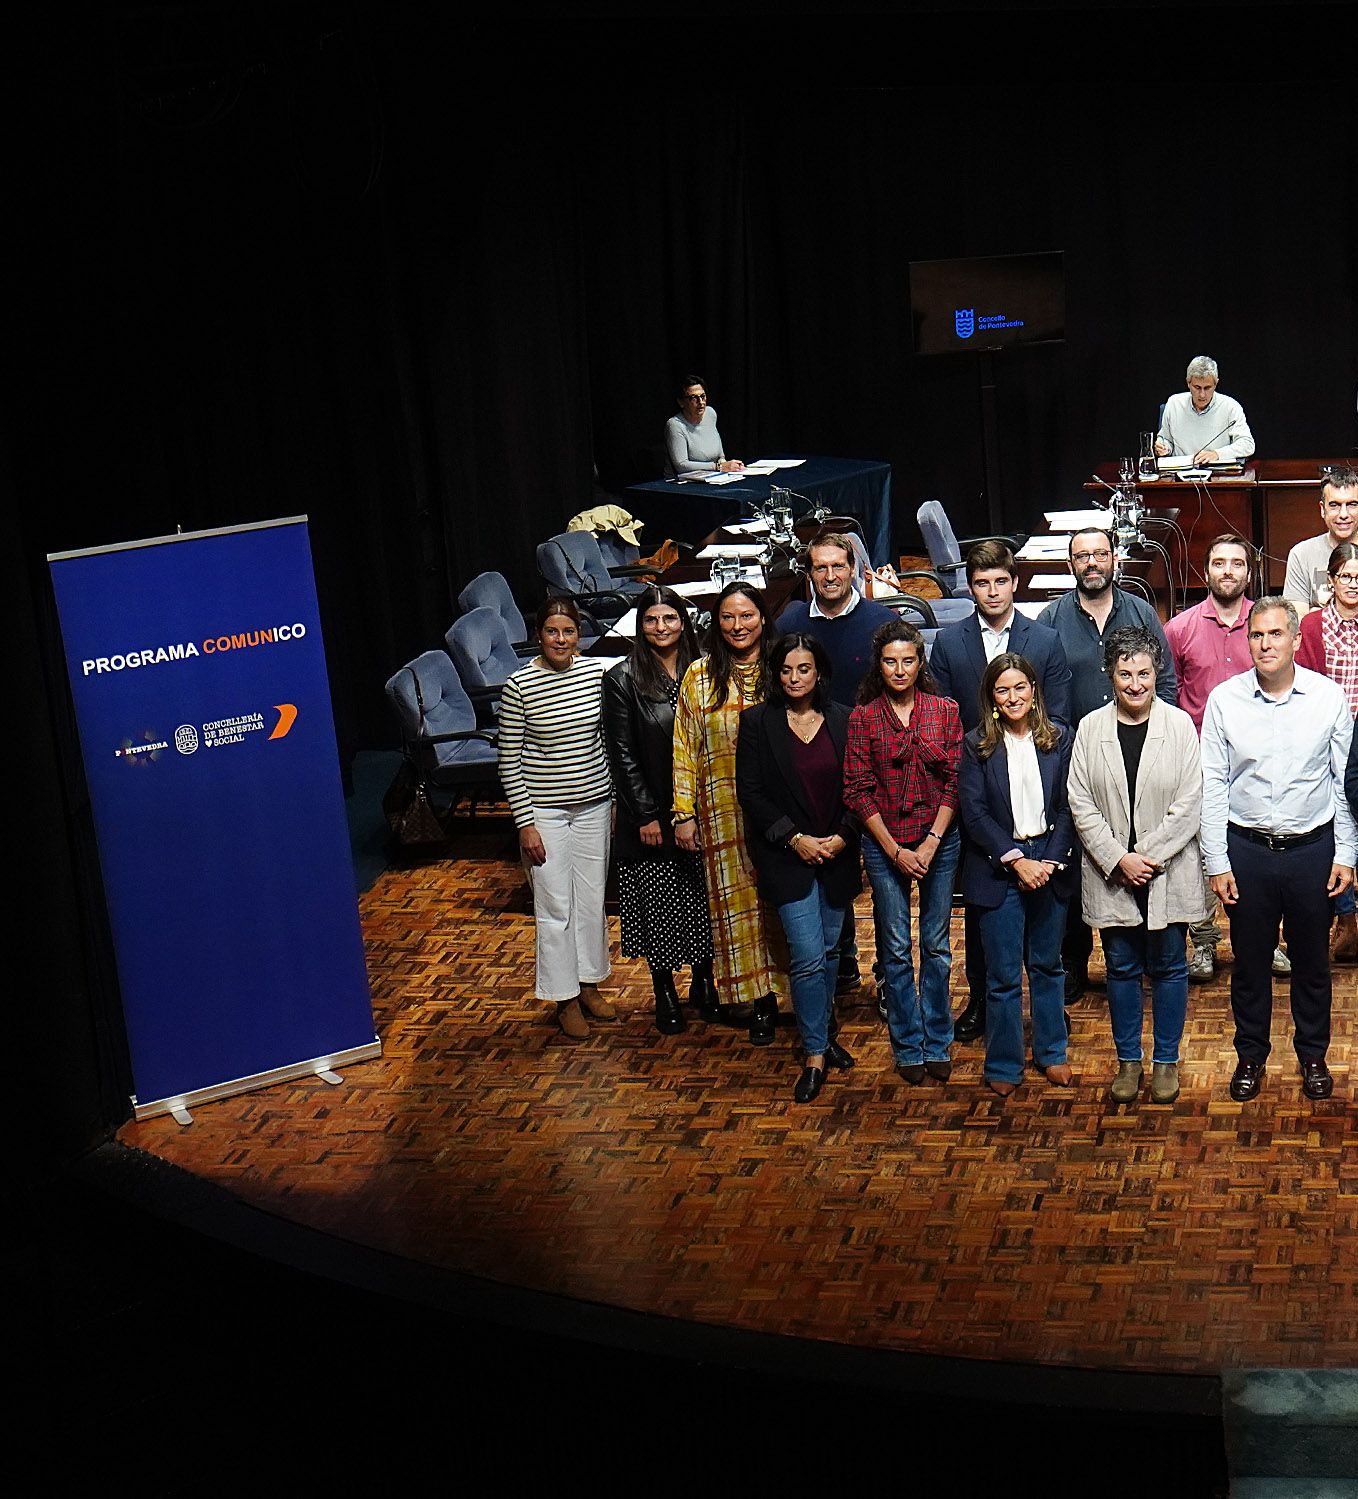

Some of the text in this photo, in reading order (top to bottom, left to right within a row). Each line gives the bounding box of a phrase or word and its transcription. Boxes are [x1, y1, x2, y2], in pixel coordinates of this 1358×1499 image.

[978, 314, 1006, 323] Concello
[82, 623, 306, 676] PROGRAMA COMUNICO
[203, 712, 264, 731] CONCELLERÍA
[204, 721, 264, 740] DE BENESTAR
[213, 734, 245, 747] SOCIAL
